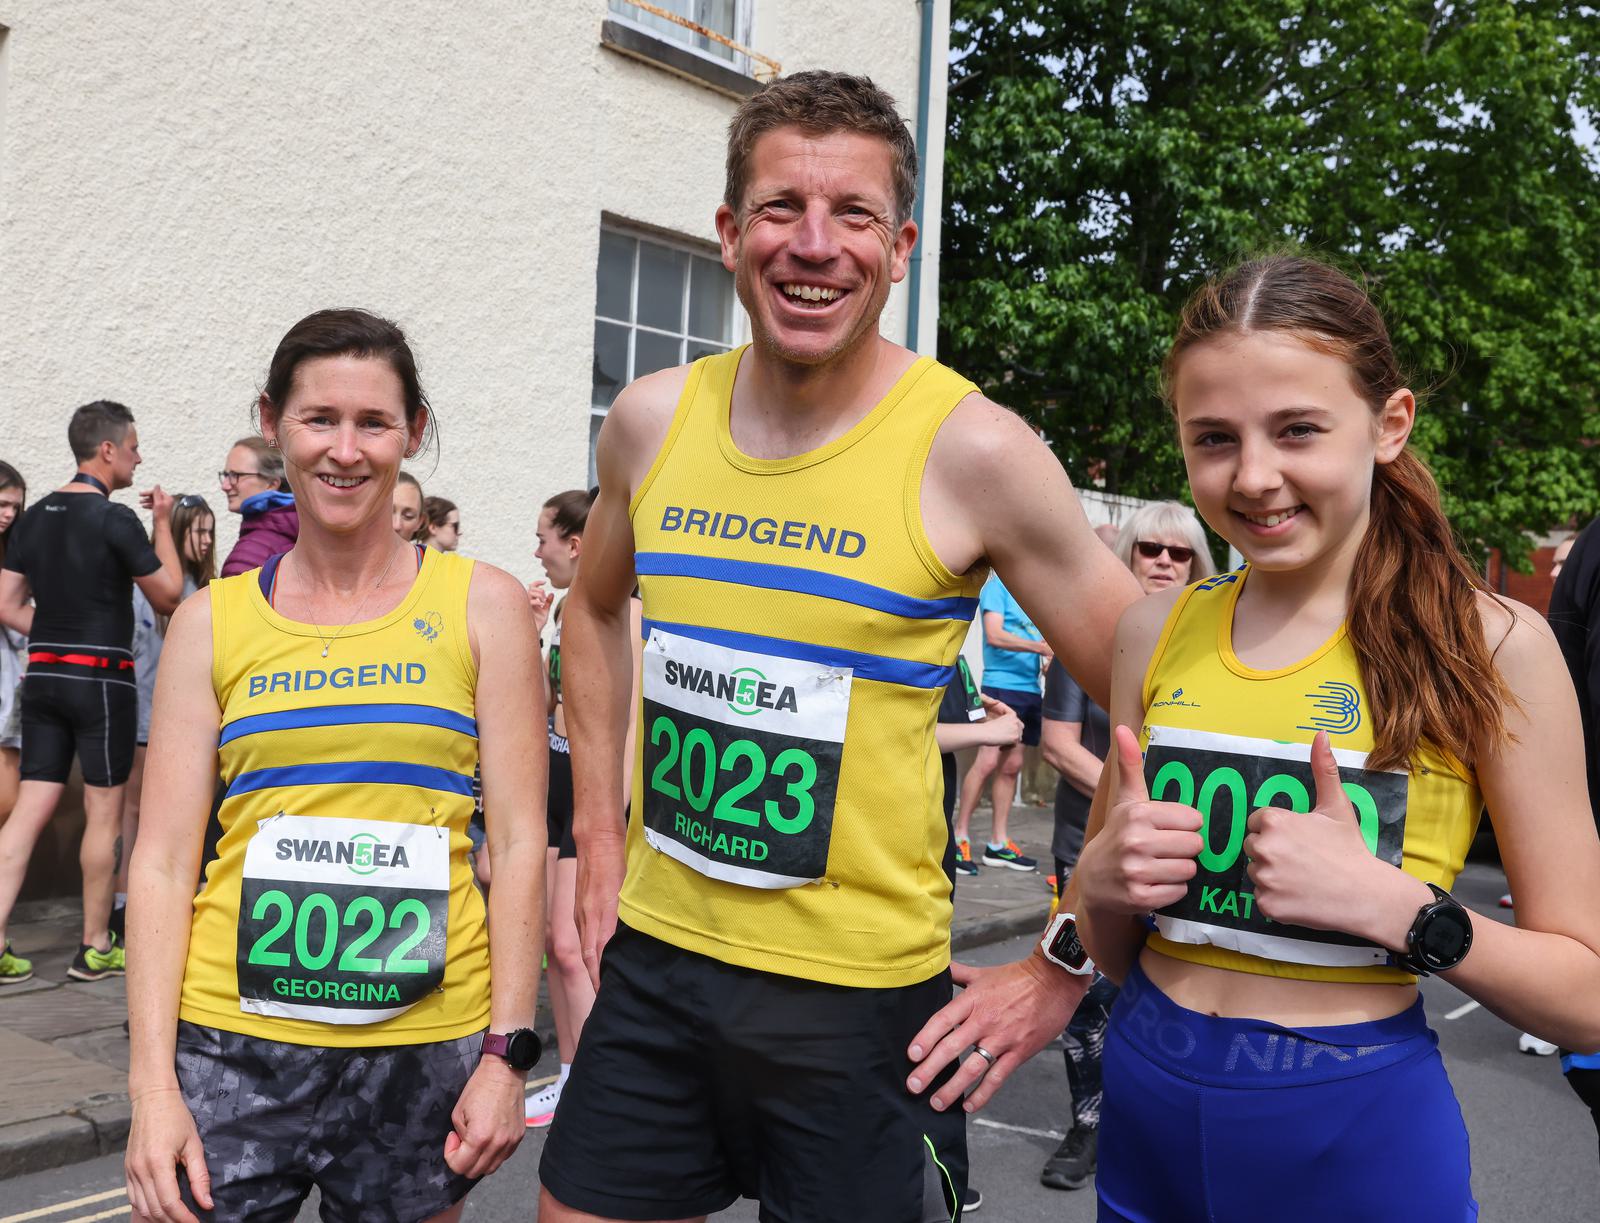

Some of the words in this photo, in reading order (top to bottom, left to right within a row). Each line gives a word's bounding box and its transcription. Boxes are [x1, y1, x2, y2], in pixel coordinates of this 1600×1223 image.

[660, 506, 866, 559] BRIDGEND
[249, 662, 427, 698] BRIDGEND
[650, 715, 818, 835] 2023
[675, 811, 769, 862] RICHARD
[1199, 885, 1274, 922] KAT
[247, 889, 430, 975] 2022
[272, 977, 401, 1003] GEORGINA
